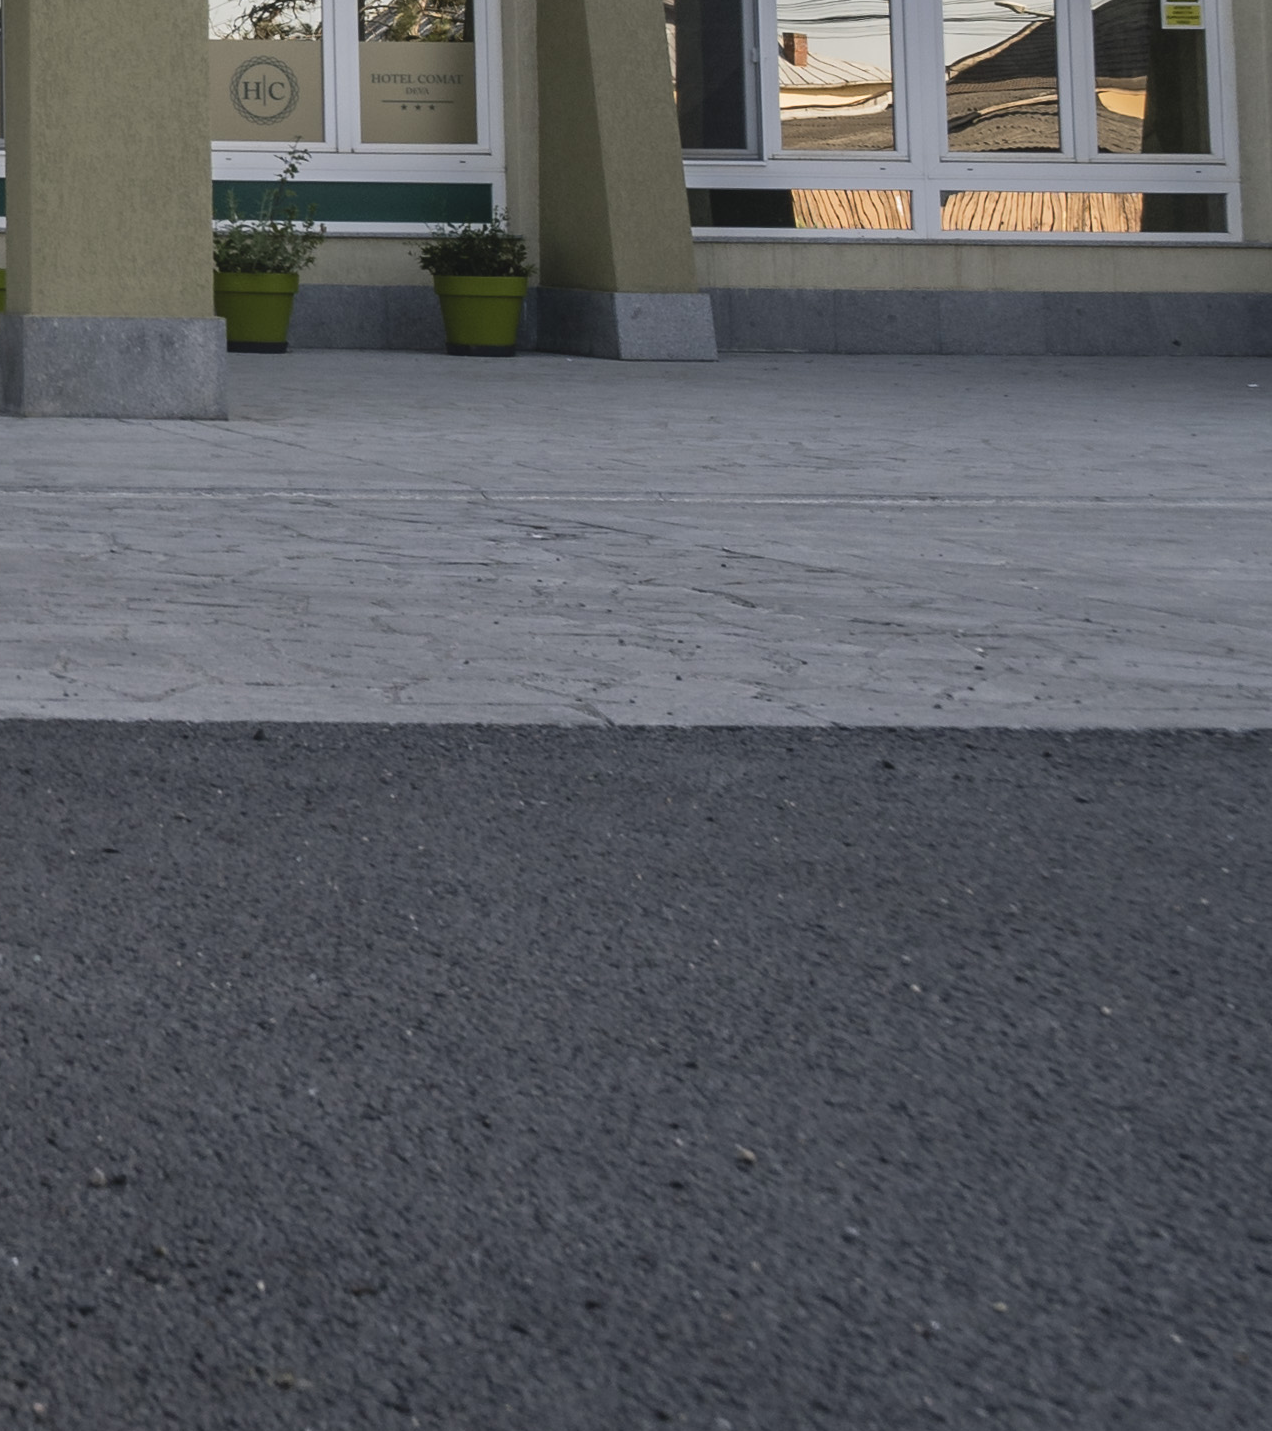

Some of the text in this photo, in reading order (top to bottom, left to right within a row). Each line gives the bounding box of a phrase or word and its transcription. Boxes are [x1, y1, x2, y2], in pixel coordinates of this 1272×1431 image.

[371, 73, 464, 85] HOTEL COMAT
[405, 86, 430, 95] DEVA
